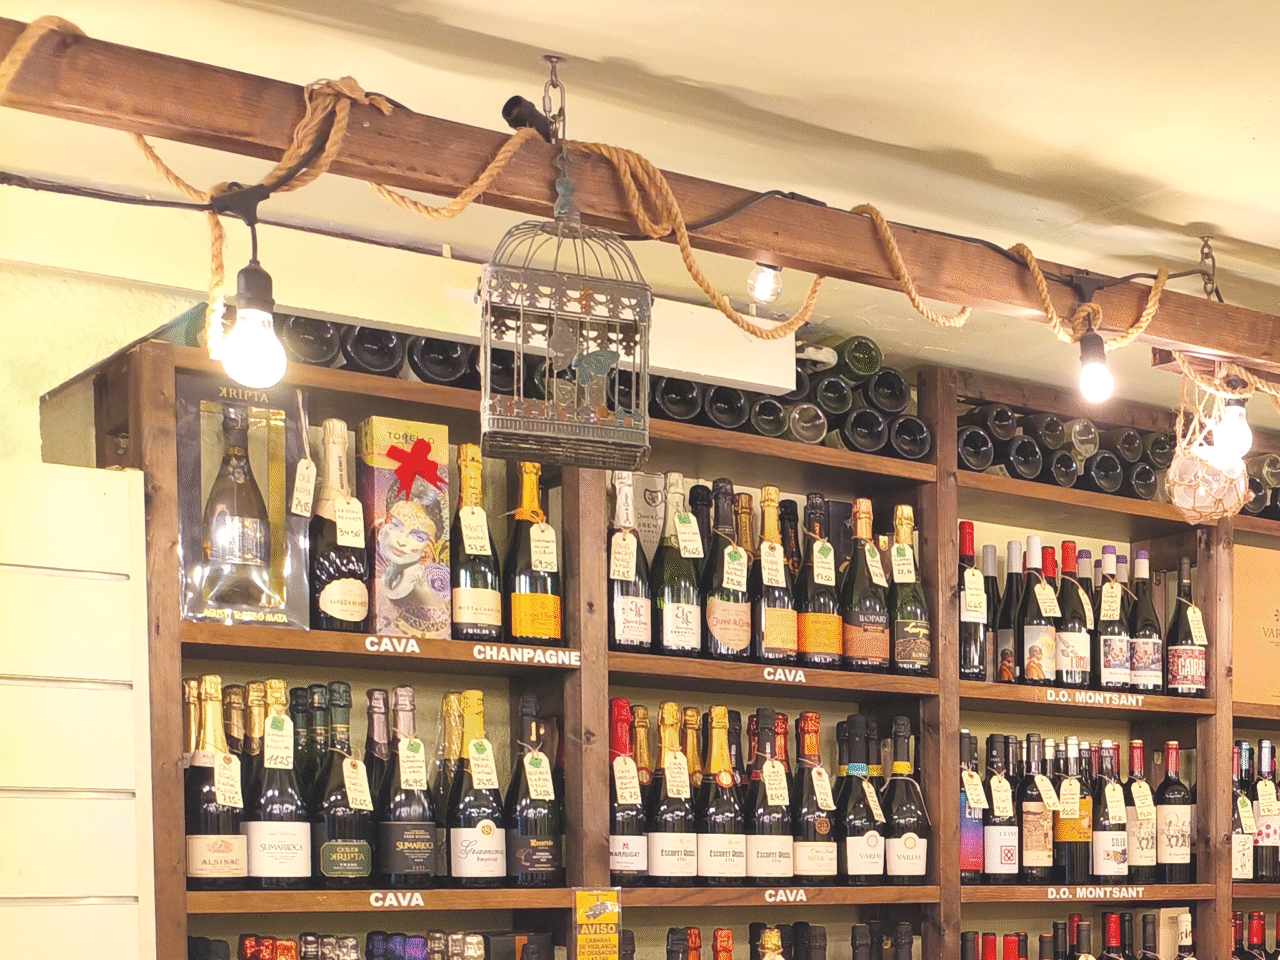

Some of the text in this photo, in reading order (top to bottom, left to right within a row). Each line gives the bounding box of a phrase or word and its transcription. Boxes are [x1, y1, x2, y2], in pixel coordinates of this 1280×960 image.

[219, 386, 269, 403] KRIPTA
[365, 637, 420, 653] CAVA
[473, 645, 581, 665] CHANPAGNE
[763, 668, 806, 683] CAVA
[1046, 689, 1144, 706] D.O. MONTSANT
[259, 841, 303, 854] SUMARROCA
[201, 857, 240, 866] ALSINAC
[896, 854, 922, 862] VARIAS
[764, 890, 807, 903] CAVA
[1047, 887, 1145, 899] D.O. MONTSANT
[369, 893, 424, 907] CAVA
[580, 924, 616, 935] AVISO
